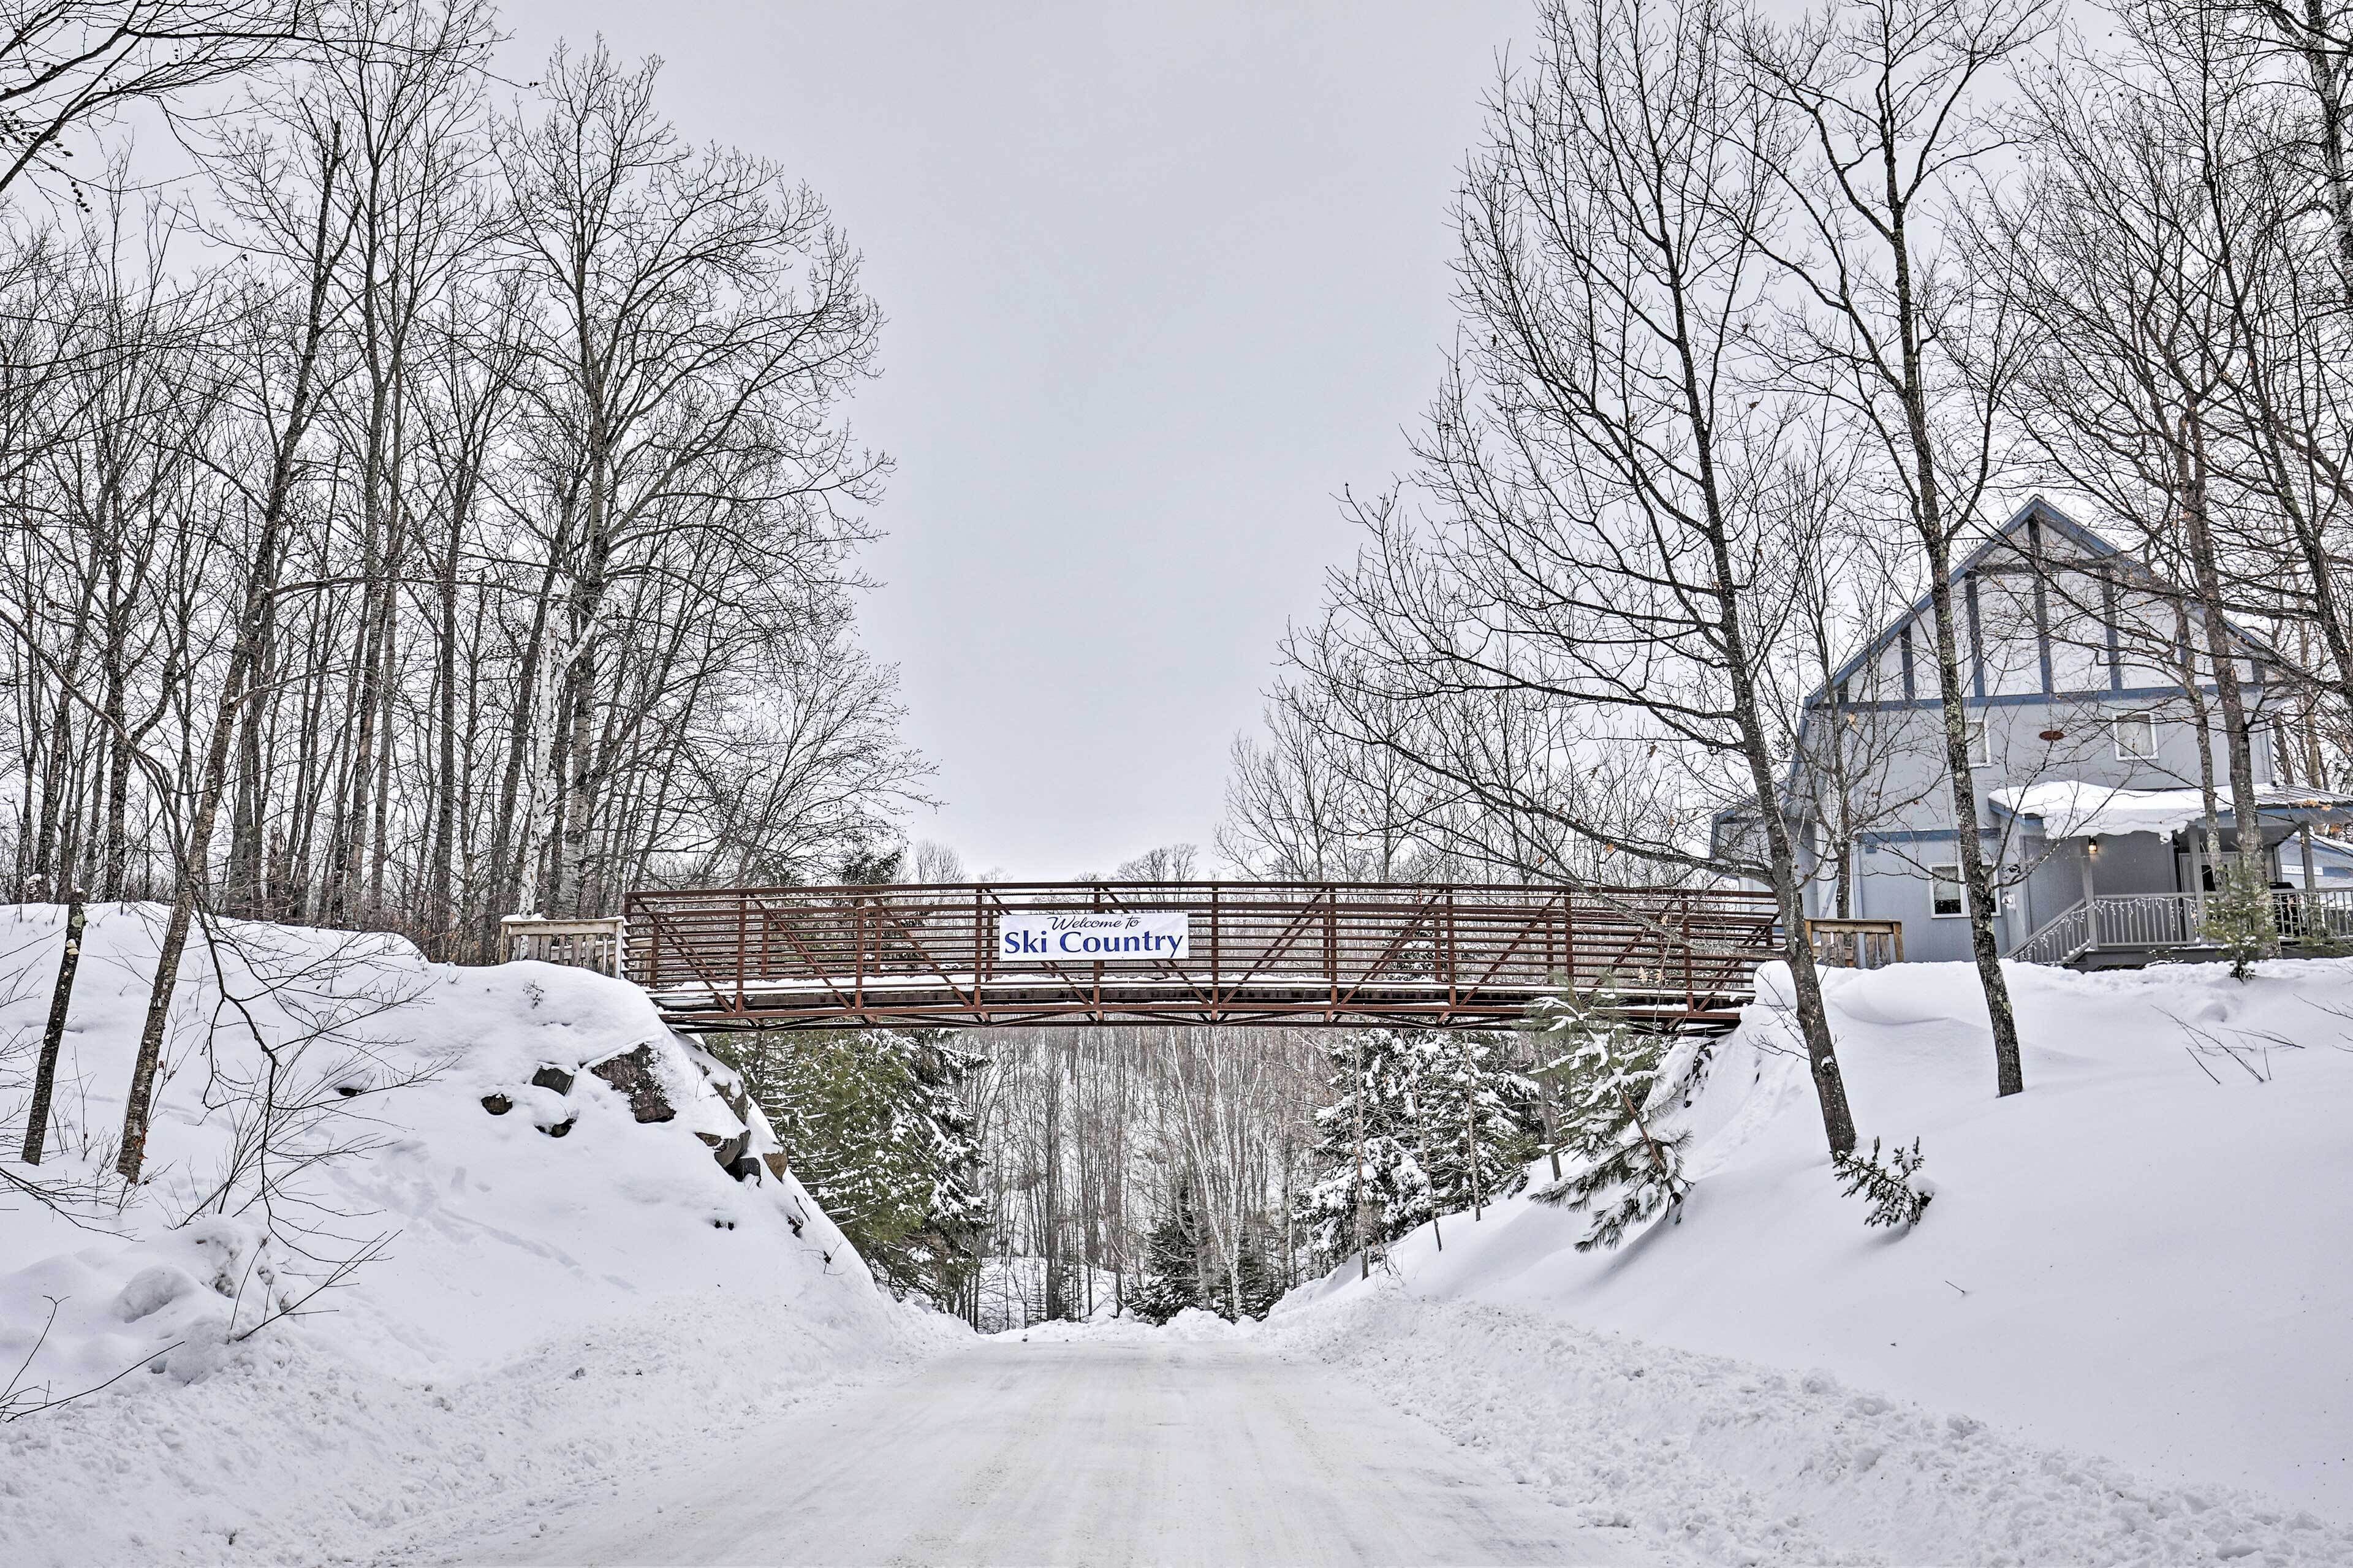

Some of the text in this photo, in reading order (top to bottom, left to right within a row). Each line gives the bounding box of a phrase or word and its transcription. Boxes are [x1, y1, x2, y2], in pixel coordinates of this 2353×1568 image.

[1047, 915, 1141, 930] Welcome to
[1005, 930, 1183, 958] Ski Country
